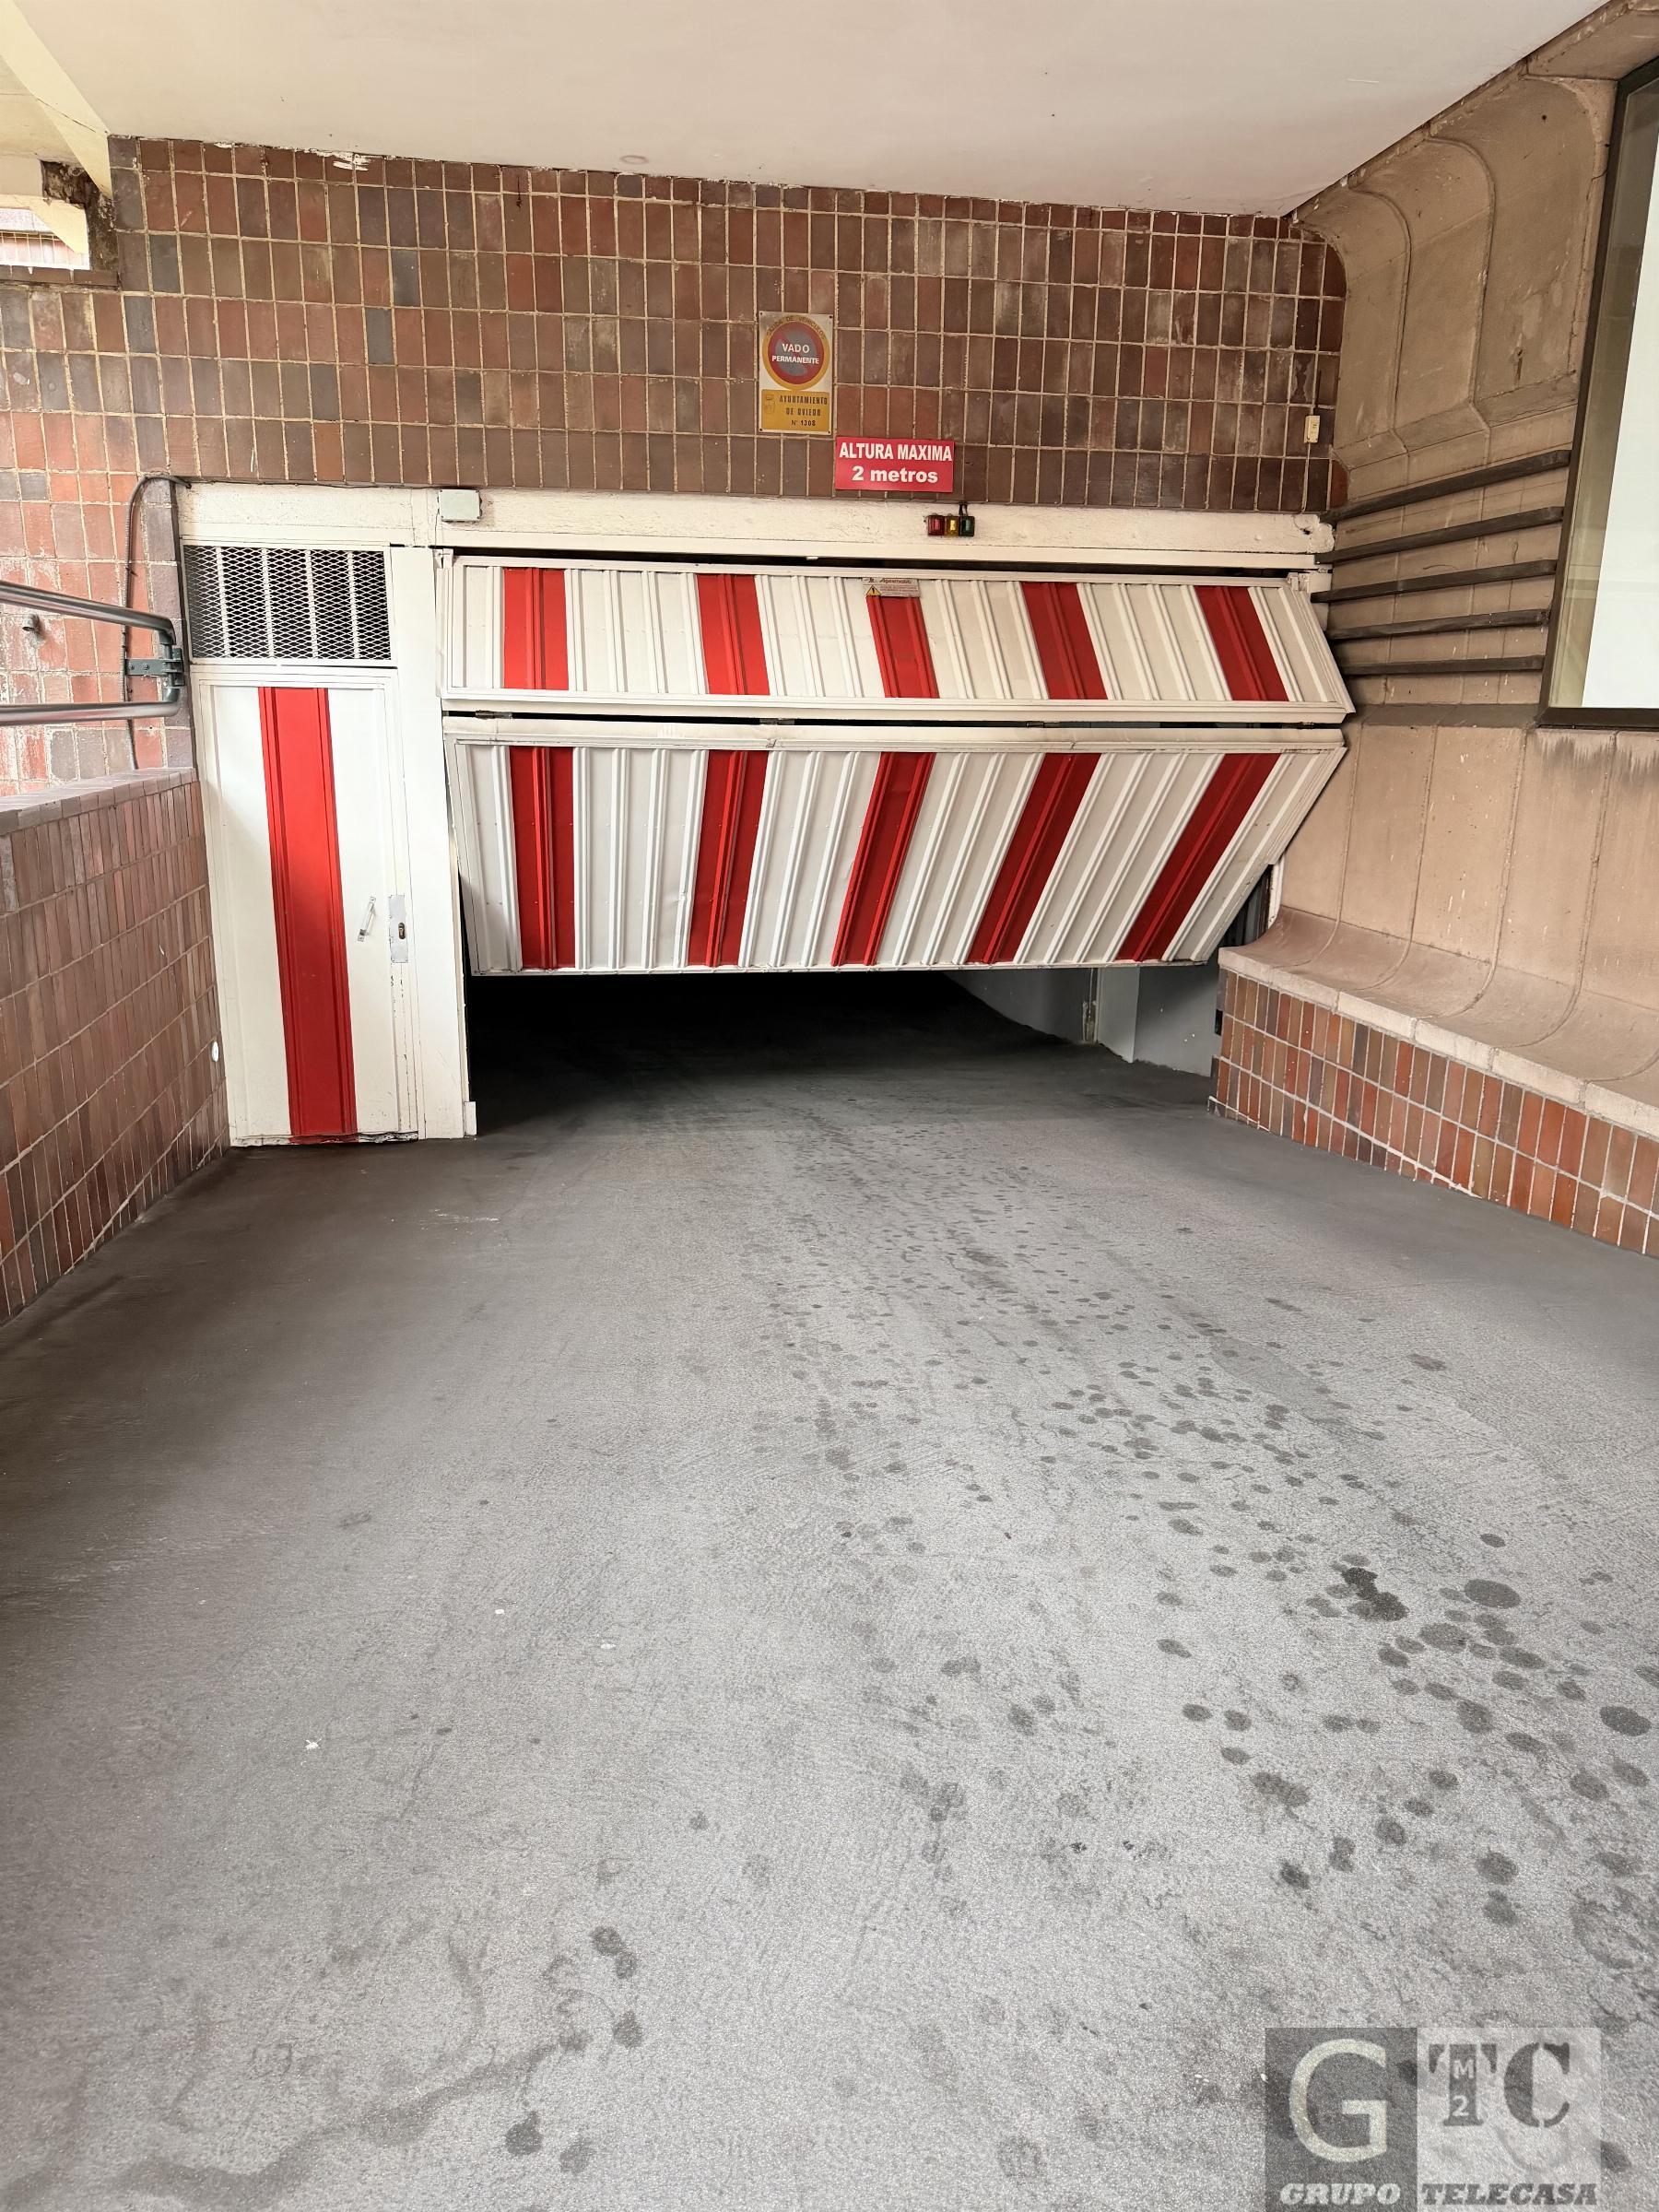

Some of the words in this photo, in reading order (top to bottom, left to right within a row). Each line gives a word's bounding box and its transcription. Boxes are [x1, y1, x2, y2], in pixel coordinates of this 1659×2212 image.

[782, 343, 810, 353] VADO
[771, 355, 820, 365] PERMANENTE
[779, 394, 829, 406] AYUNTAMIENTO
[786, 407, 794, 416] DE
[797, 407, 821, 417] OVIEDO
[839, 441, 894, 459] ALTURA
[897, 443, 953, 461] MAXIMA
[852, 465, 865, 481] 2
[870, 467, 938, 483] metros
